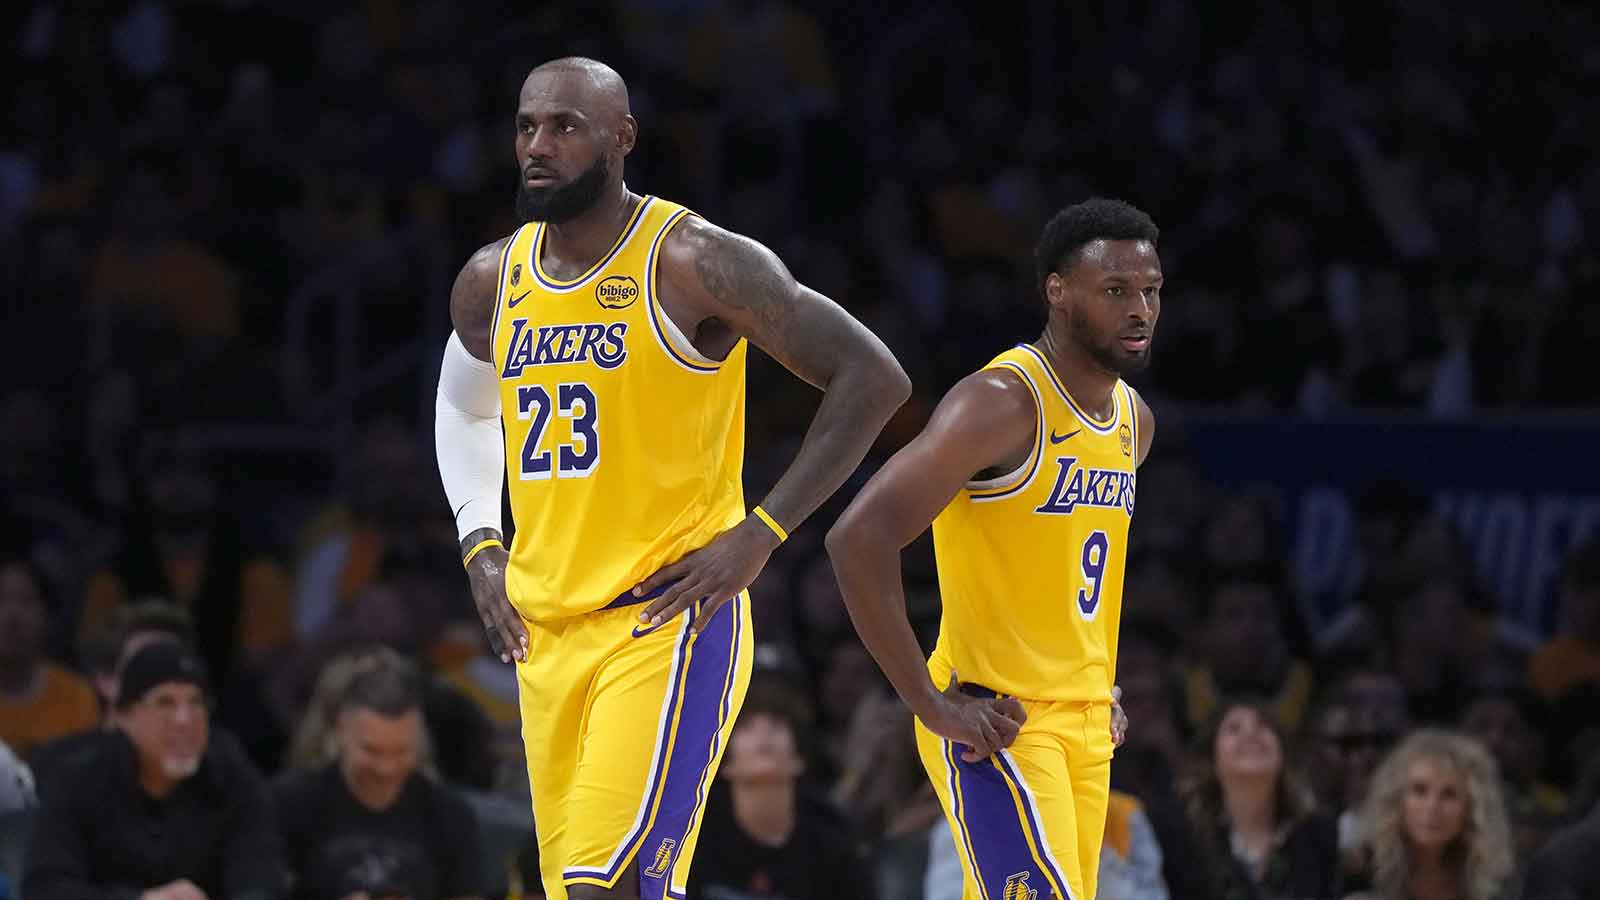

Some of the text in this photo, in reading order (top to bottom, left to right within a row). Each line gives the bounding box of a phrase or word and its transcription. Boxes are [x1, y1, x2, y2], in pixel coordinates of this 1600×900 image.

[600, 284, 636, 299] bibigo
[502, 318, 628, 379] LAKERS
[517, 383, 600, 480] 23
[1033, 456, 1136, 519] LAKERS
[1076, 529, 1109, 621] 9
